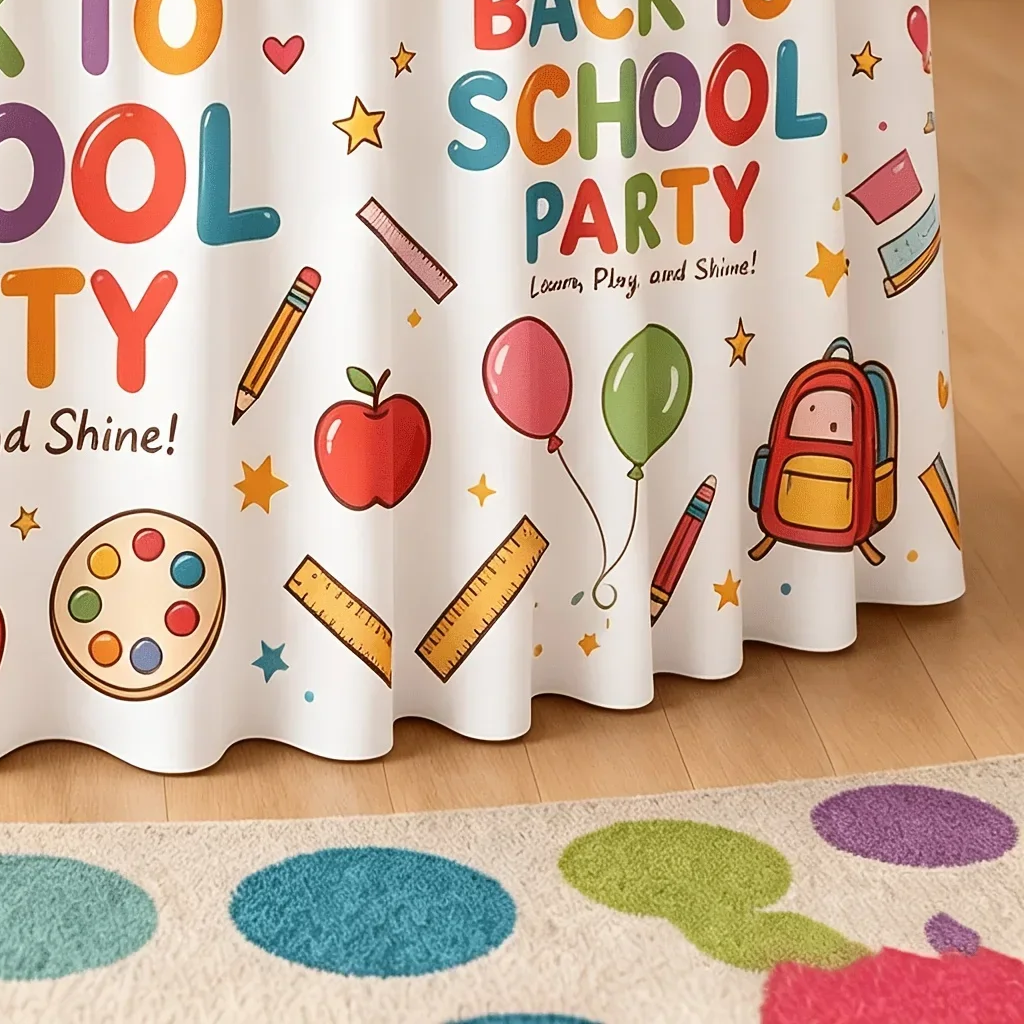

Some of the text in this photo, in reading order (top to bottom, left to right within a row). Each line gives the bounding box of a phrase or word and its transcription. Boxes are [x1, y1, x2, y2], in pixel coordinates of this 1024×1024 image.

[447, 39, 828, 171] SCHOOL
[525, 160, 760, 264] PARTY
[44, 407, 179, 455] Shine!
